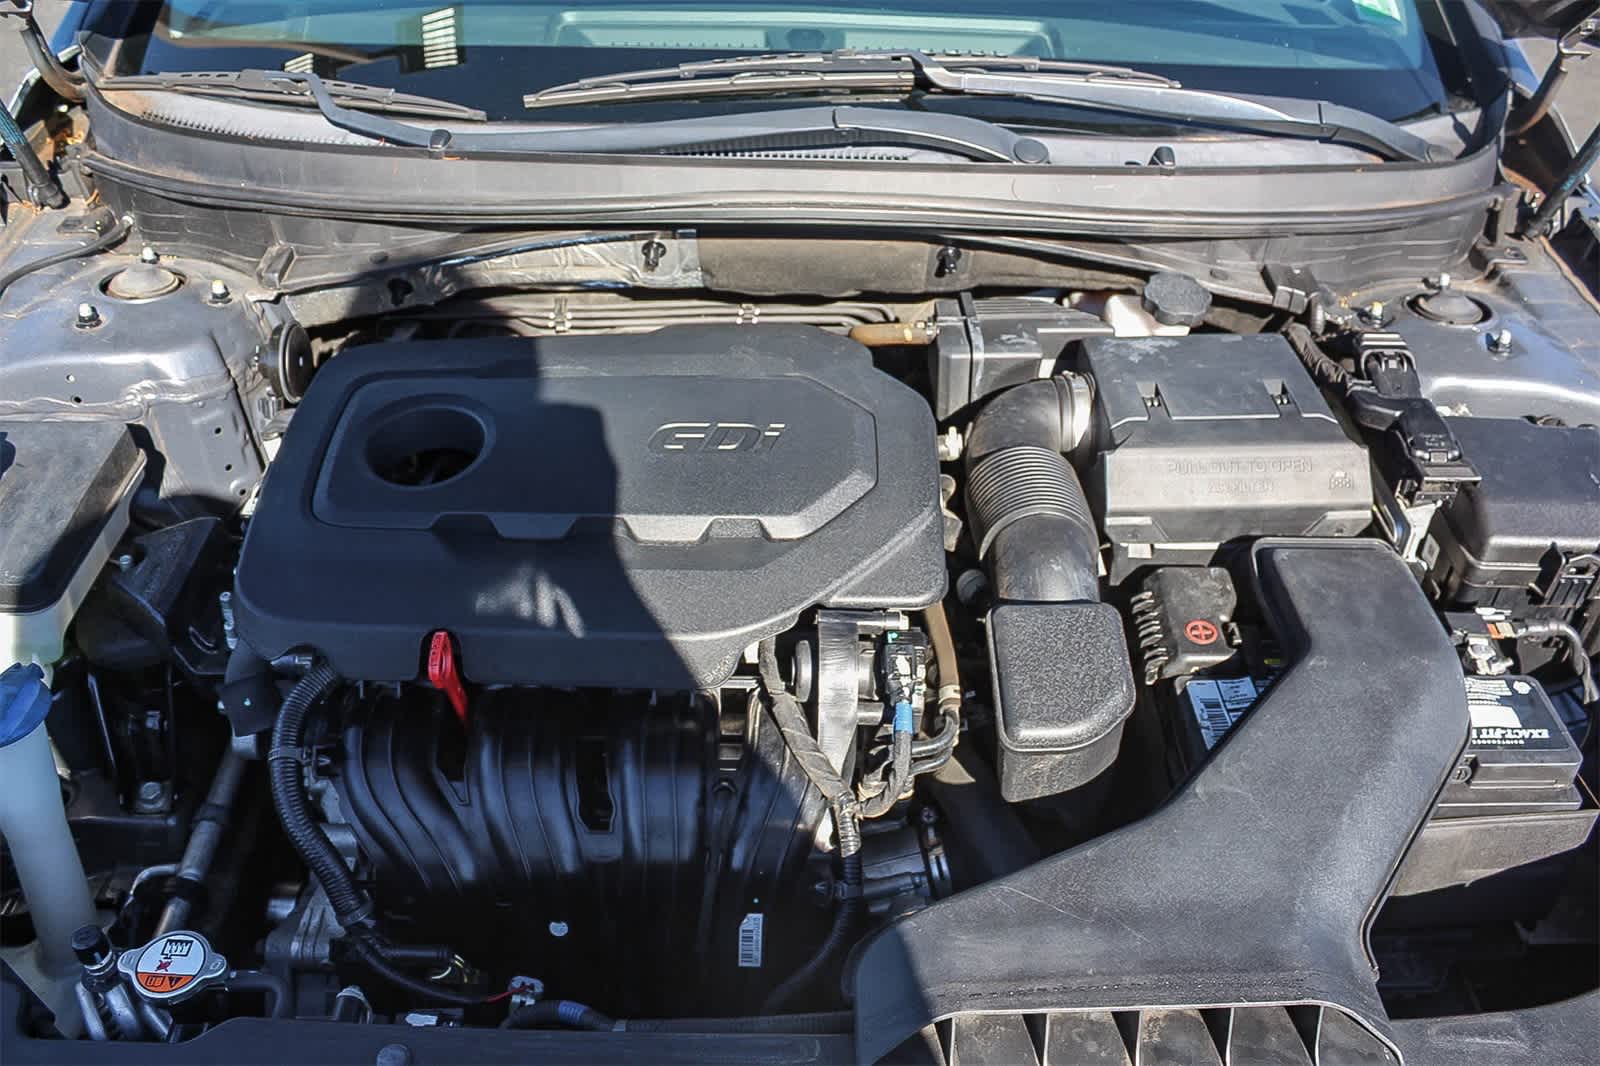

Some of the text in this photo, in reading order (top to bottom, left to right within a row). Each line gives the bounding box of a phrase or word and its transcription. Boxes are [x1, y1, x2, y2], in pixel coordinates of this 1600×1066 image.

[1167, 455, 1313, 475] PULL OUT TO OPEN
